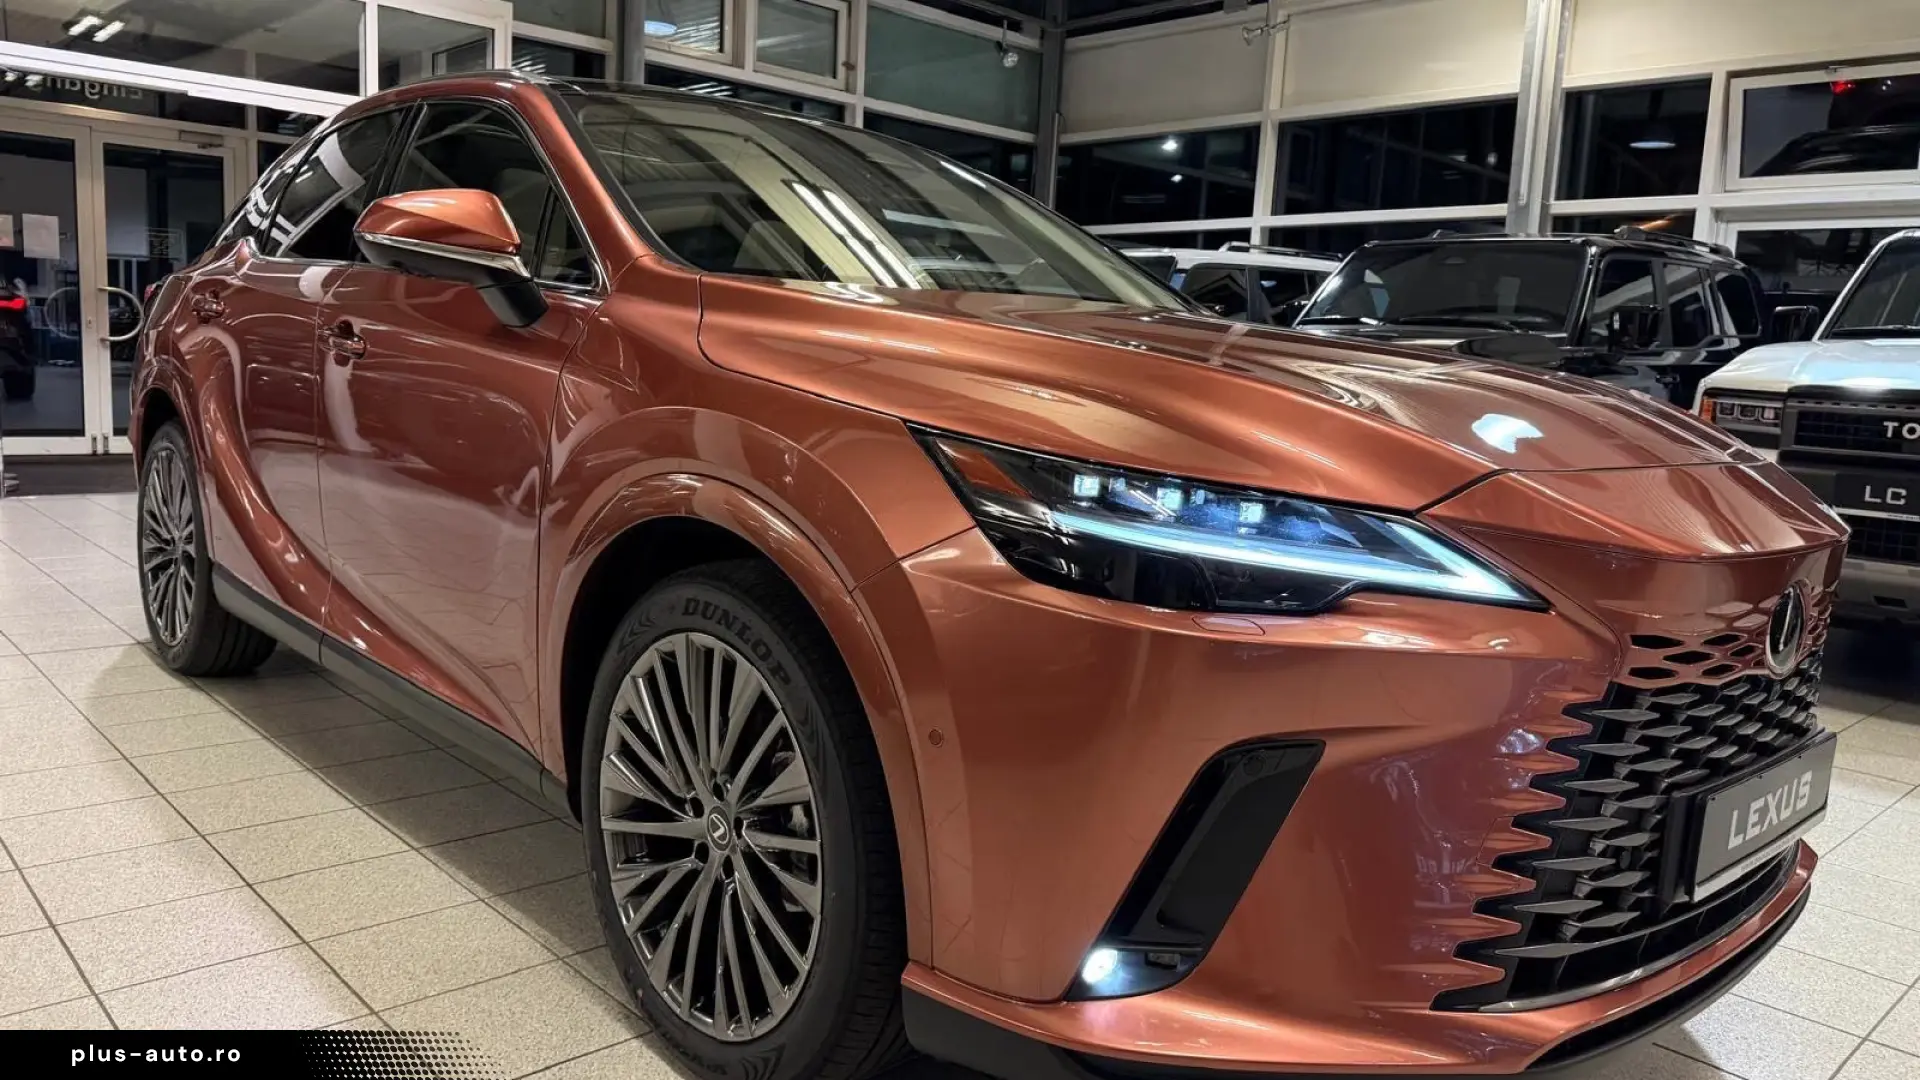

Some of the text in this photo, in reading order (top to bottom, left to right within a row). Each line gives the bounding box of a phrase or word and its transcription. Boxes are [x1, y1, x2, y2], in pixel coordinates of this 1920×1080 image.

[1864, 485, 1908, 505] LC
[682, 597, 792, 687] DUNLOP
[1727, 770, 1813, 850] LEXUS
